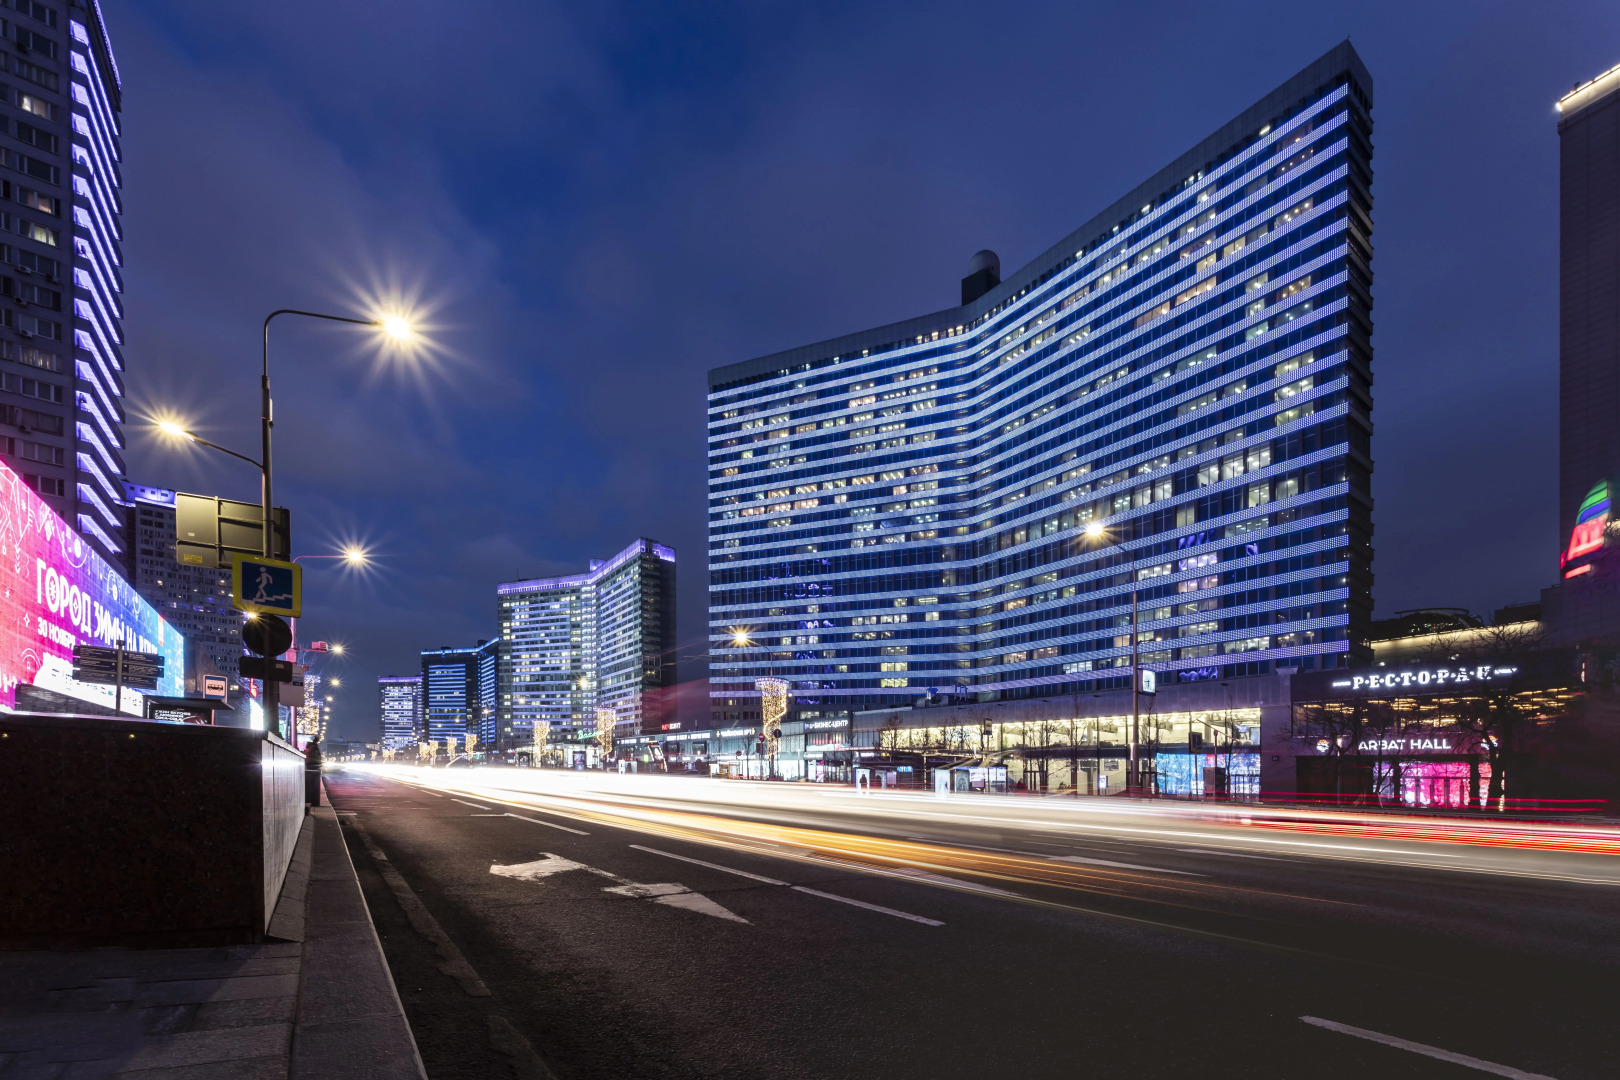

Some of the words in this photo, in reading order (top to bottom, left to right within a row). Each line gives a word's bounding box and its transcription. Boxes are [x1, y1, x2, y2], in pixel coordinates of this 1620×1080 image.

[37, 557, 92, 637] ГОРОД
[93, 600, 125, 651] ЗИМЫ
[126, 625, 138, 652] НА
[38, 616, 48, 638] 30
[1358, 739, 1406, 751] ARBAT
[1410, 738, 1452, 750] HALL
